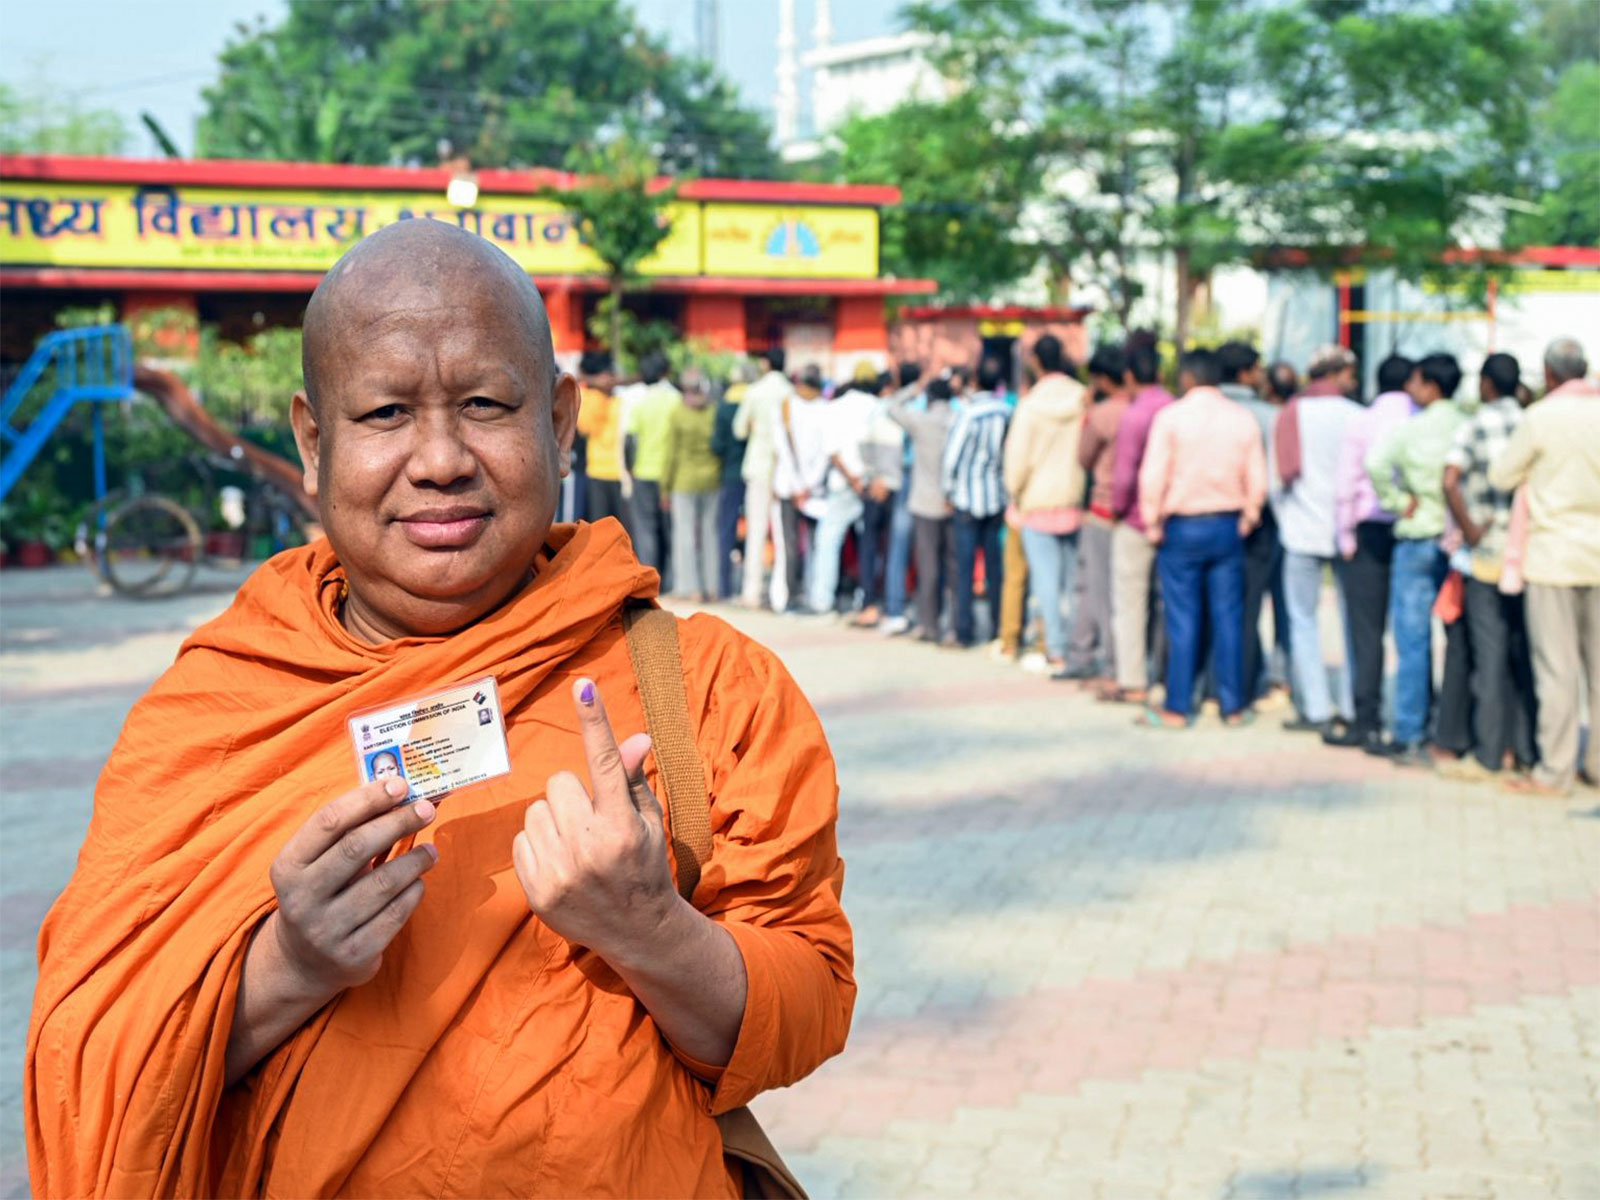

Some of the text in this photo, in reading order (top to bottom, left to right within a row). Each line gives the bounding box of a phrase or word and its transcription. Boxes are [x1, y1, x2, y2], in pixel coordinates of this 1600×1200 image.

[379, 721, 407, 734] ELECTION
[407, 711, 442, 726] COMMISSION
[451, 704, 466, 713] INDIA
